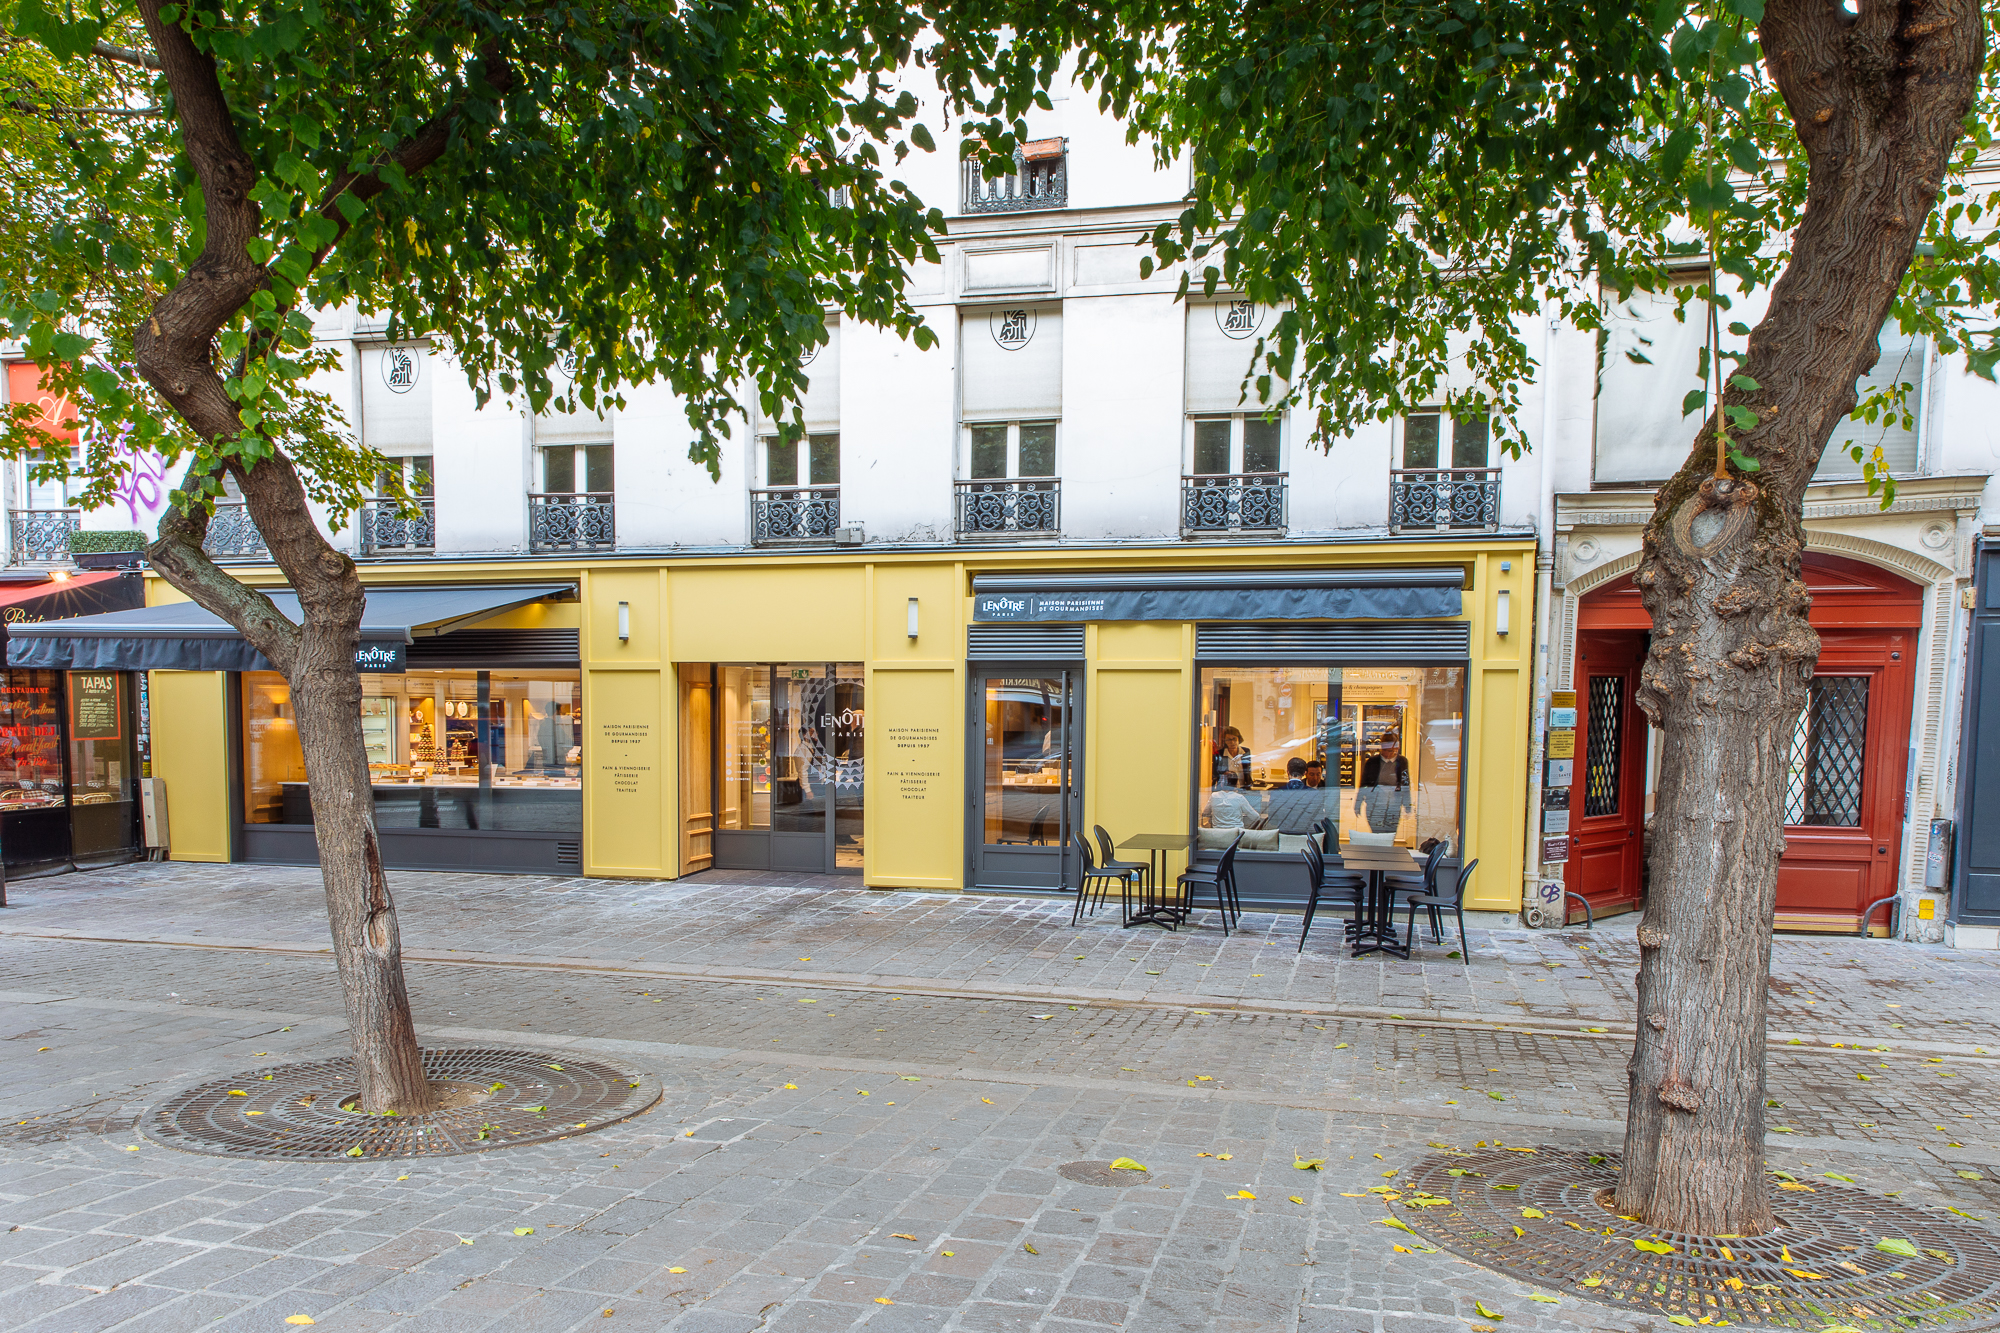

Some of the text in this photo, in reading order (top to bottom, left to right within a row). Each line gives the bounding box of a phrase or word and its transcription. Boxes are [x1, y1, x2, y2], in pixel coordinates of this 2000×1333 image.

[982, 597, 1025, 611] LENÔTRE
[355, 646, 396, 662] LENÔTRE
[81, 676, 112, 690] TAPAS
